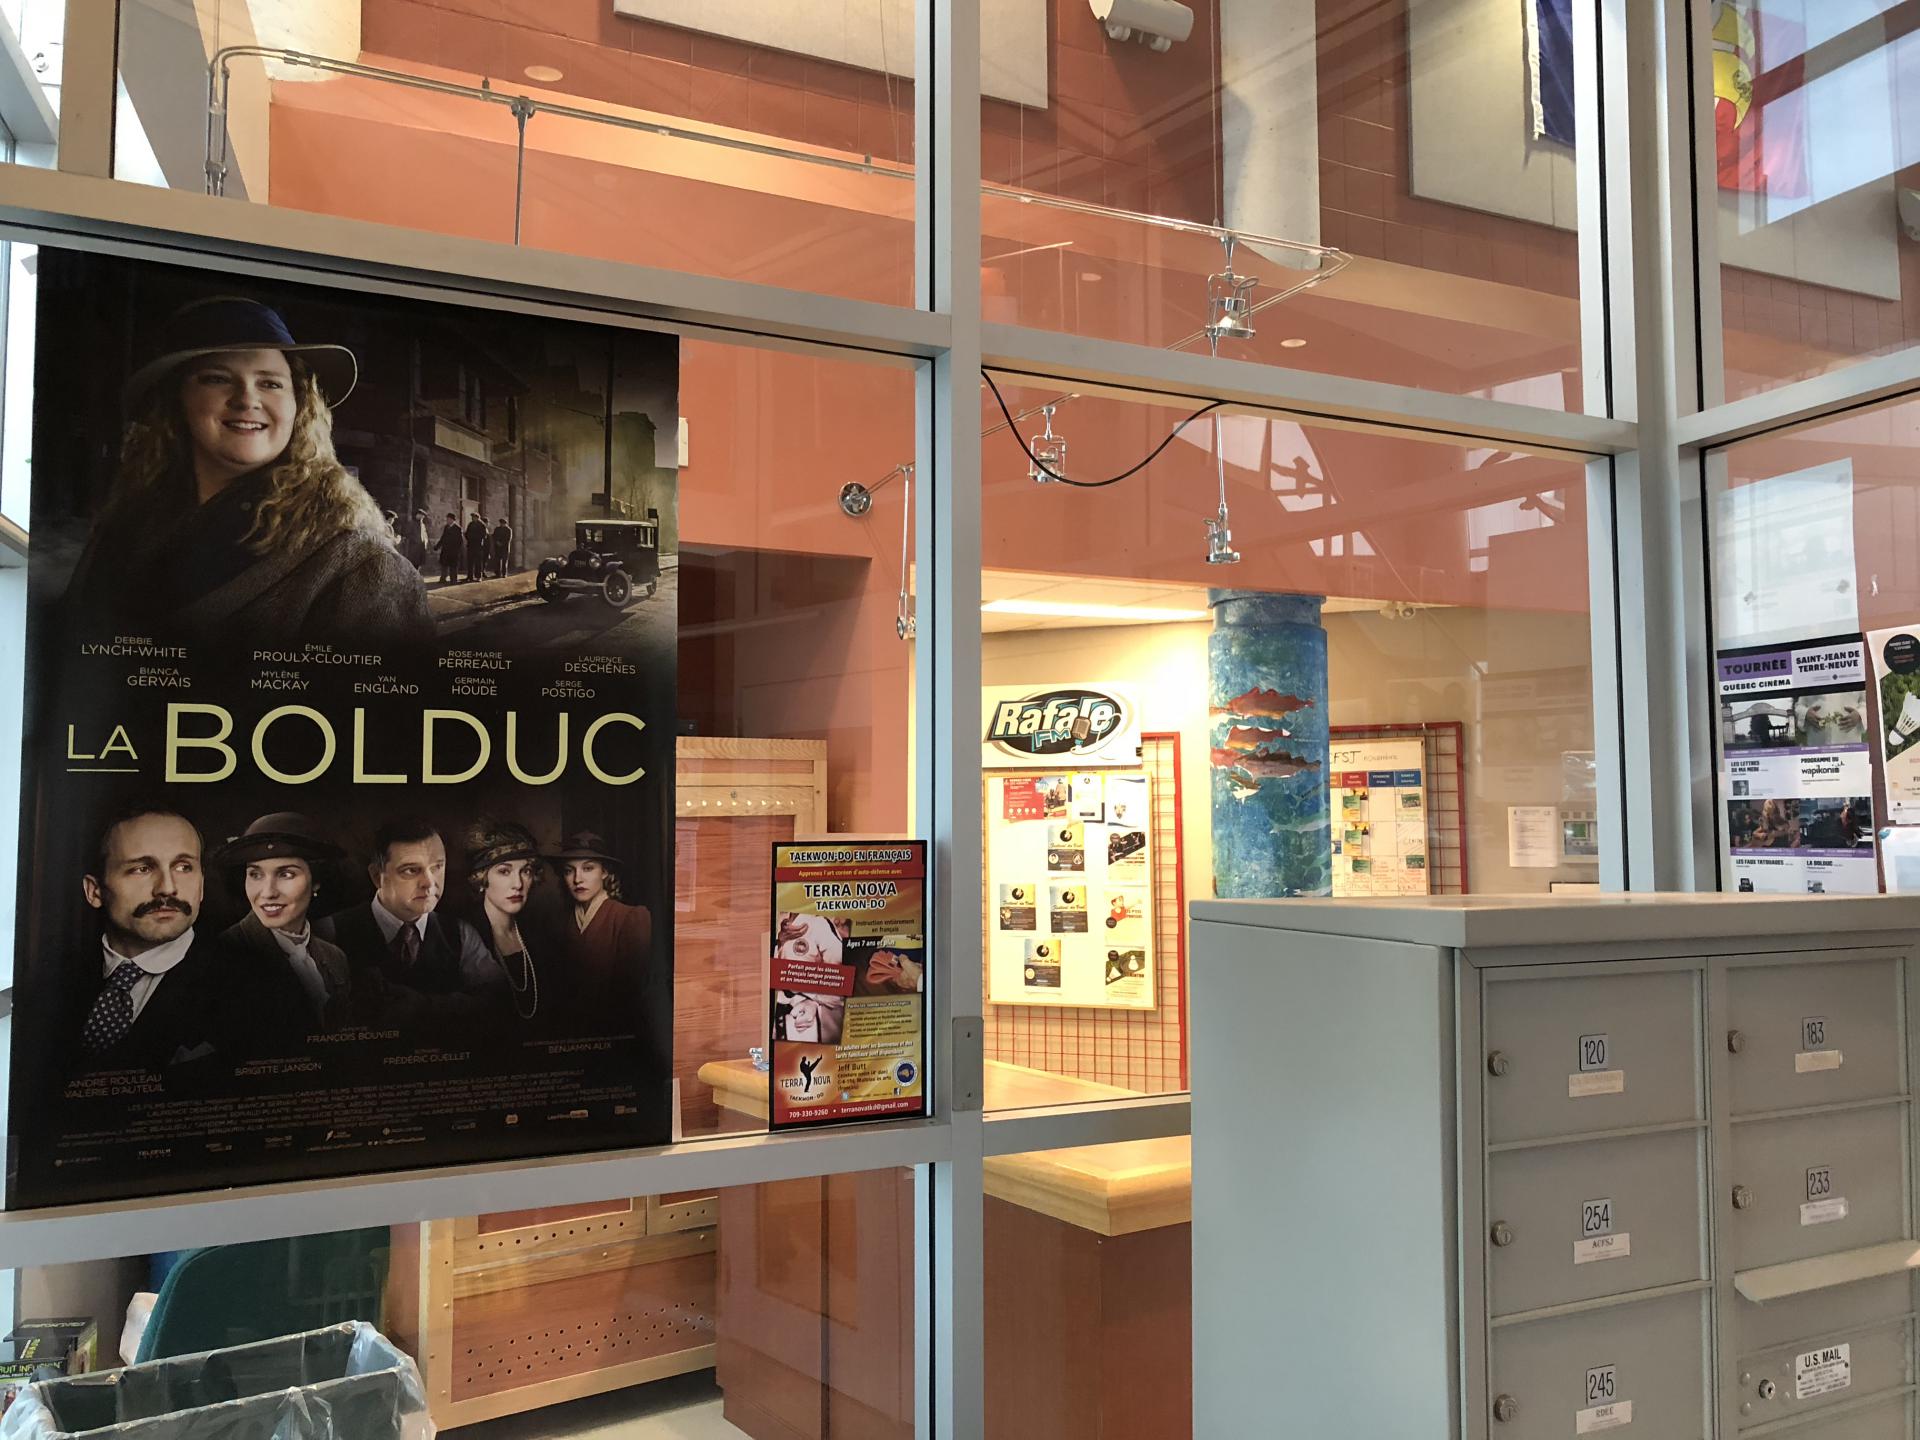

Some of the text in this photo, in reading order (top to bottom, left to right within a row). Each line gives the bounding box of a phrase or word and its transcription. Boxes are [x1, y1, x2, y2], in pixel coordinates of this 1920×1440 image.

[115, 636, 152, 645] DEBBIE
[81, 644, 187, 659] LYNCH-WHITE
[253, 650, 381, 665] PROULX-CLOUTIER
[448, 650, 502, 660] ROSE-MARIE
[1796, 650, 1860, 665] SAINT-JEAN DE
[438, 658, 513, 671] PERREAULT
[578, 655, 623, 664] LAURENCE
[1798, 659, 1858, 673] TERRE-NEUVE
[139, 667, 179, 676] BIANCA
[564, 661, 636, 675] DESCHÊNES
[127, 675, 191, 688] GERVAIS
[251, 679, 310, 691] MACKAY
[377, 675, 396, 684] YAN
[454, 676, 495, 686] GERMAIN
[555, 680, 582, 688] SERGE
[354, 682, 419, 695] ENGLAND
[451, 684, 498, 697] HOUDE
[541, 687, 596, 699] POSTIGO
[990, 698, 1116, 737] Rafale
[67, 702, 646, 785] LA BOLDUC
[1032, 728, 1071, 750] FM
[789, 849, 911, 863] TAEKWON-DO EN FRANÇAIS
[804, 882, 897, 898] TERRA NOVA
[816, 899, 886, 911] TAEKWON-DO
[1806, 1021, 1824, 1044] 183
[1584, 1039, 1605, 1065] 120
[780, 1078, 804, 1088] TERRA
[813, 1075, 831, 1086] NOVA
[1809, 1171, 1830, 1195] 233
[1585, 1203, 1609, 1231] 254
[1804, 1347, 1841, 1368] U.S. MAIL
[1589, 1371, 1614, 1400] 245
